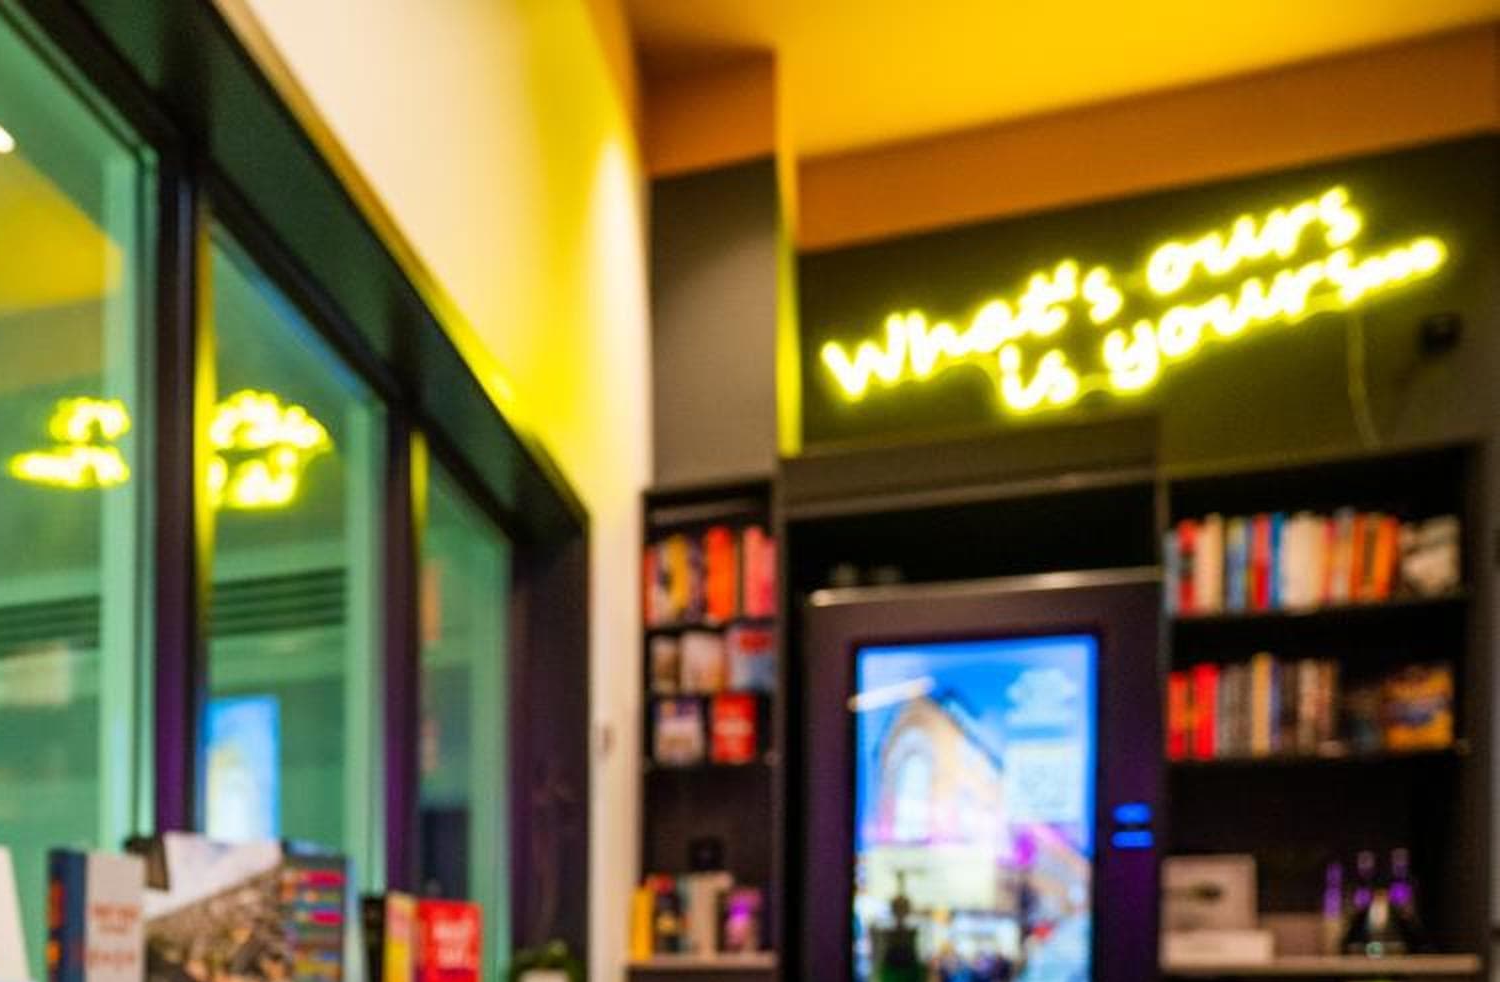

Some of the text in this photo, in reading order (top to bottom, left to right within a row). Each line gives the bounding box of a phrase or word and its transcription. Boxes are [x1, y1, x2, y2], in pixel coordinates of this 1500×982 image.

[822, 185, 1363, 402] What's ours
[999, 238, 1448, 413] is yours
